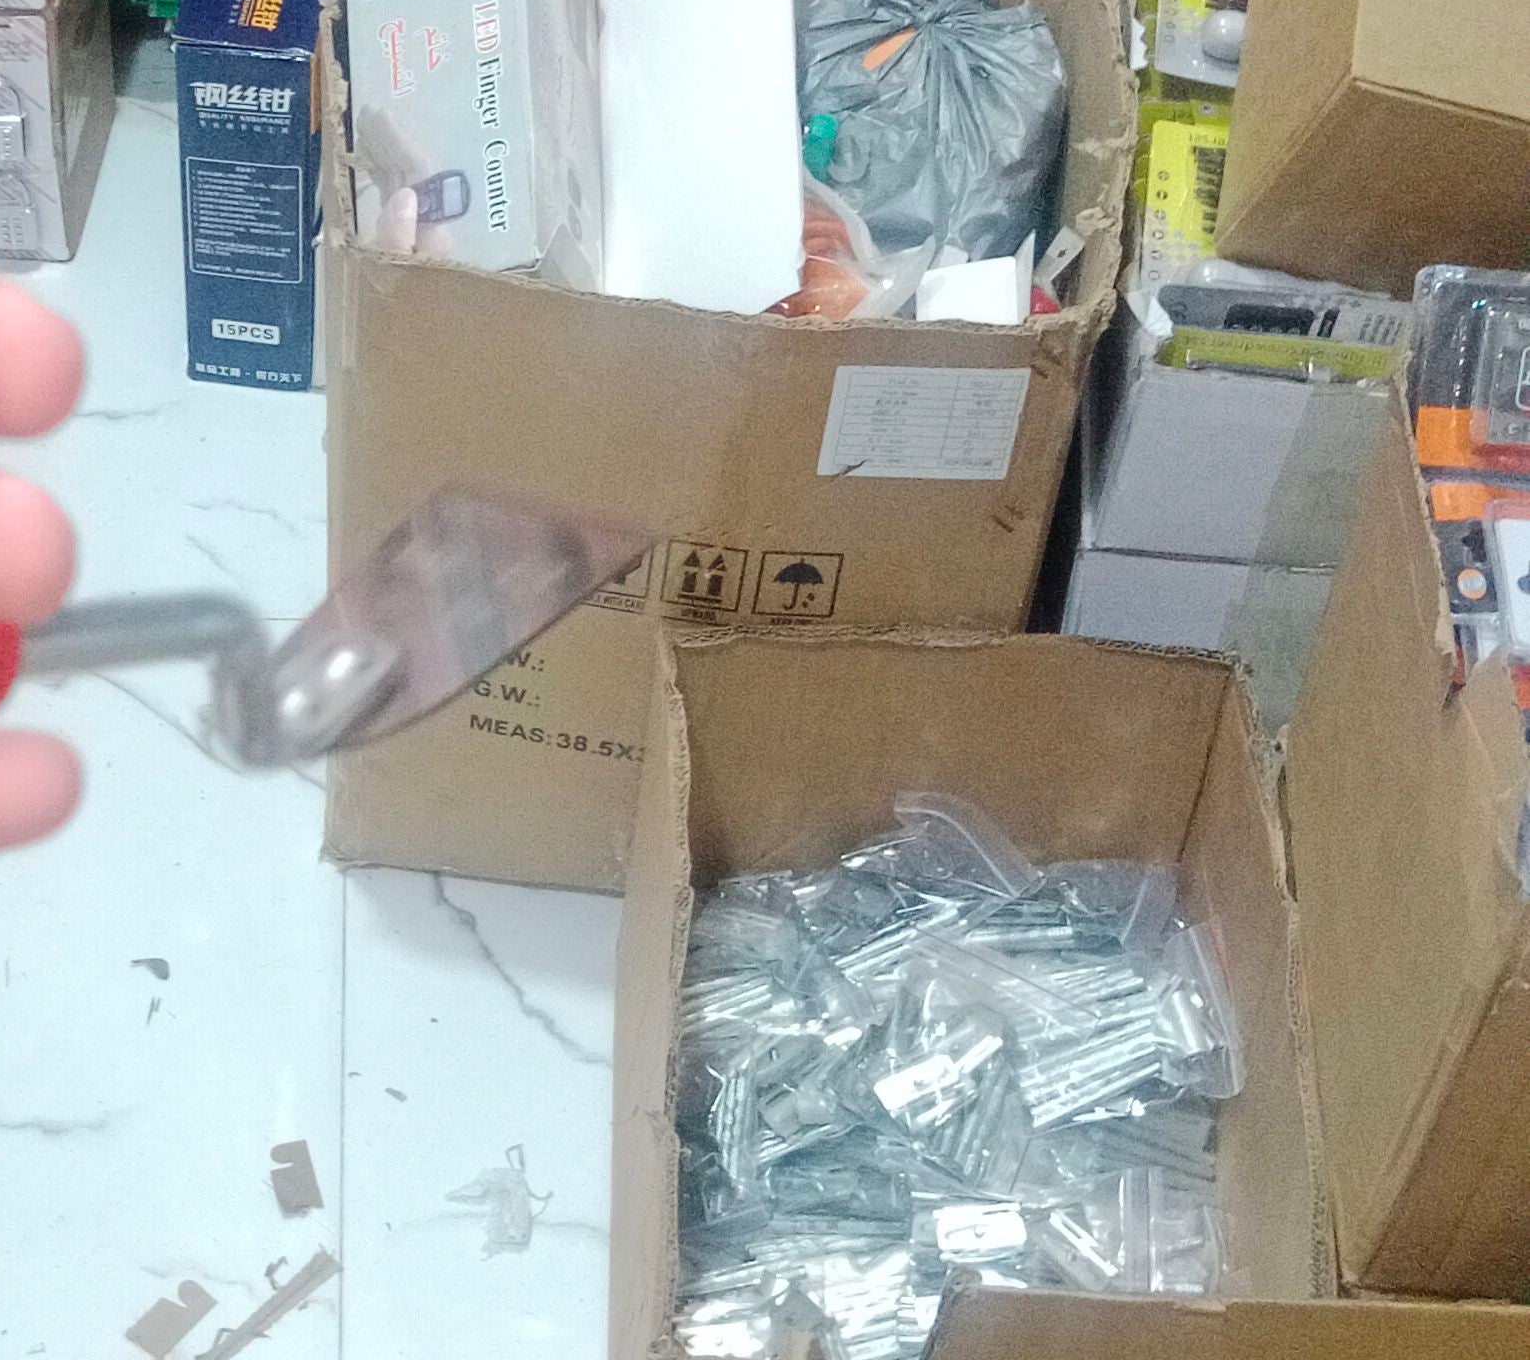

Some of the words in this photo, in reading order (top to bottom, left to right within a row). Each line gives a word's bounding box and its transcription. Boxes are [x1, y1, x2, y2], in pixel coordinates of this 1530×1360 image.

[473, 1, 498, 52] LED
[189, 81, 297, 113] 钢丝钳
[473, 55, 502, 128] Finger
[482, 139, 510, 232] Counter
[217, 322, 275, 340] 15PCS
[473, 679, 541, 708] G.W.:
